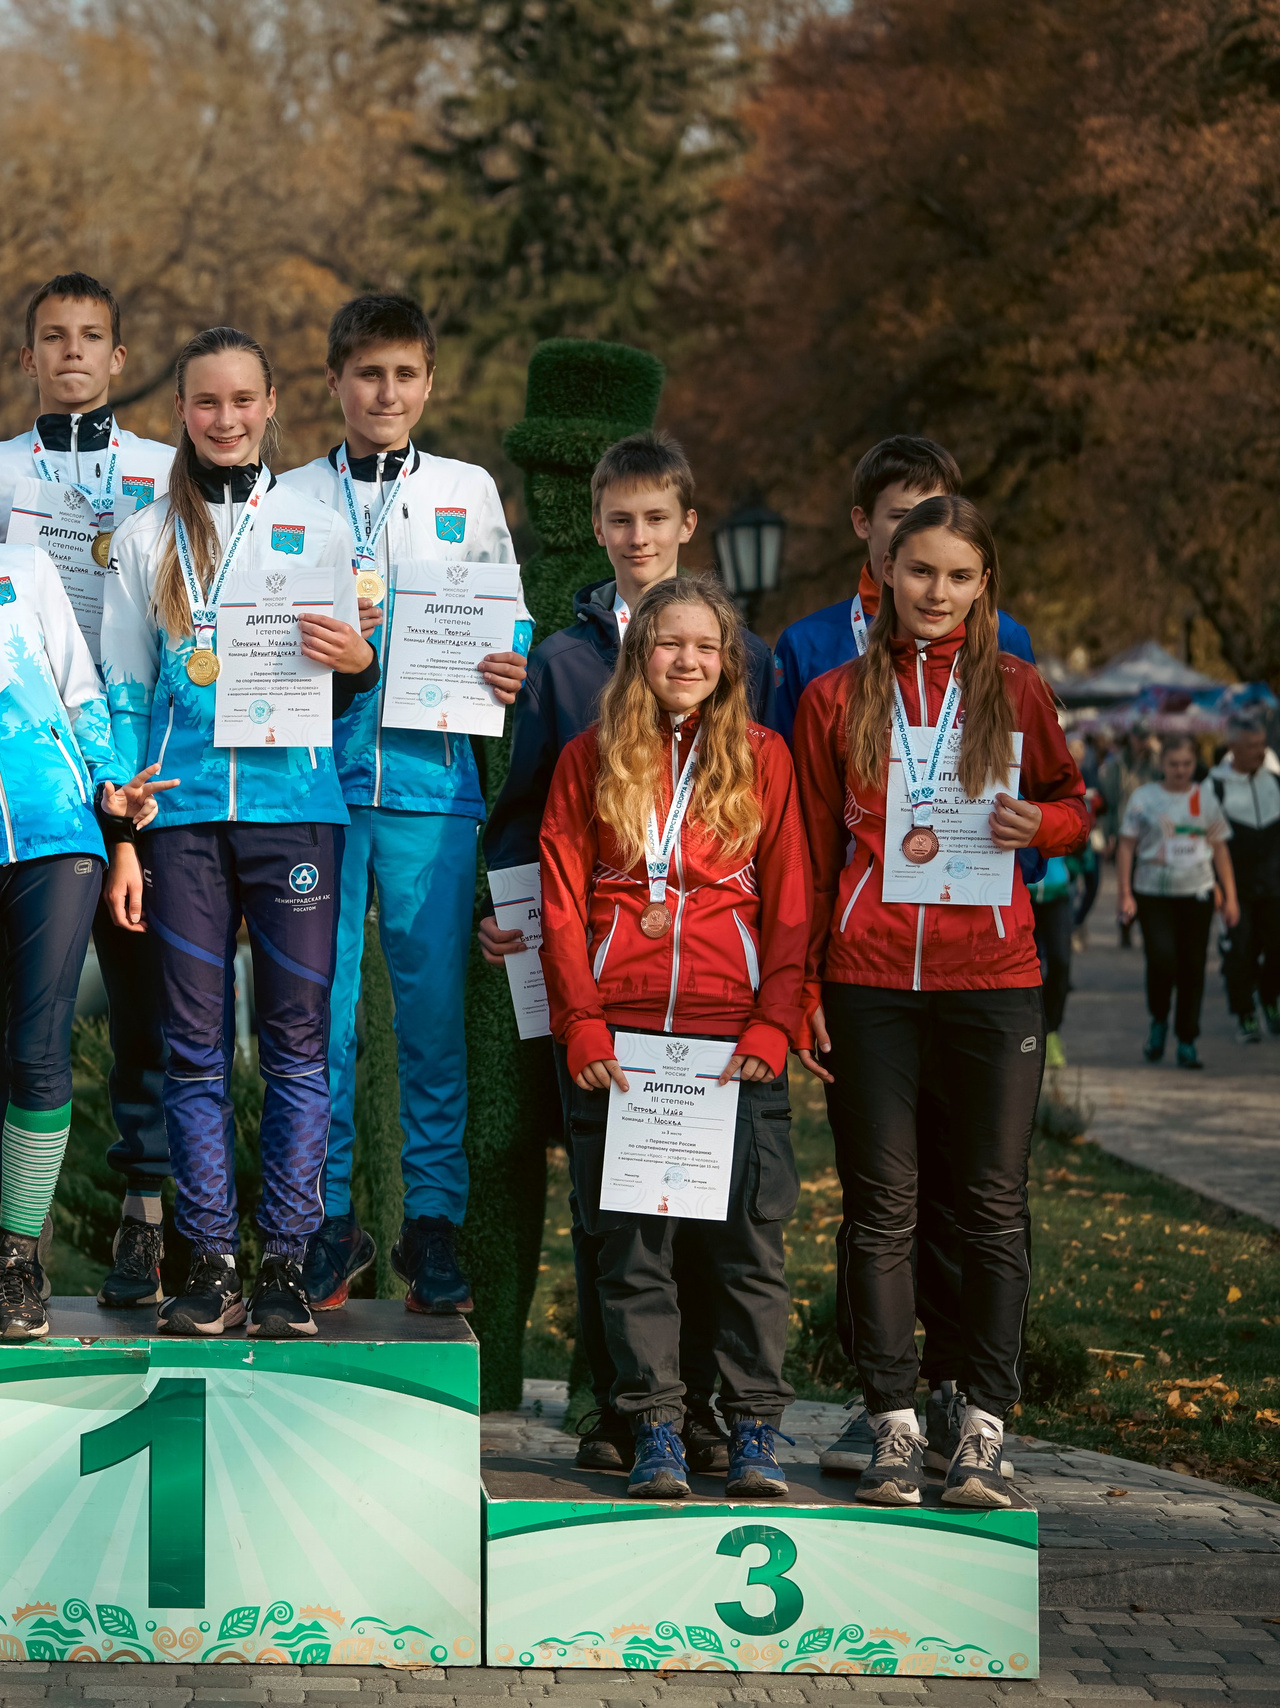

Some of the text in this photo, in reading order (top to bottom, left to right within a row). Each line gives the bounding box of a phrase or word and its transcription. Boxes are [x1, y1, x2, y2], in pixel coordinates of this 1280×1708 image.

[108, 453, 116, 475] РОССИИ
[39, 526, 97, 542] ДИПЛОМ
[53, 541, 84, 552] степень
[209, 513, 250, 604] МИНИСТЕРСТВО СПОРТА РОССИИ
[183, 554, 199, 603] СПОРТА РОССИИ
[424, 603, 483, 616] ДИПЛОМ
[246, 614, 301, 625] ДИПЛОМ
[928, 686, 957, 780] МИНИСТЕРСТВО СПОРТА РОССИИ
[900, 733, 917, 782] СПОРТА РОССИИ
[662, 809, 679, 856] МИНИСТЕРСТВО
[676, 785, 687, 808] СПОРТА
[275, 896, 321, 904] ЛЕНИНГРАДСКАЯ
[643, 1081, 705, 1097] ДИПЛОМ
[627, 1102, 657, 1114] Петрова
[660, 1097, 694, 1106] степень
[654, 1117, 681, 1126] Москва
[80, 1377, 205, 1608] 1
[714, 1524, 804, 1636] 3
